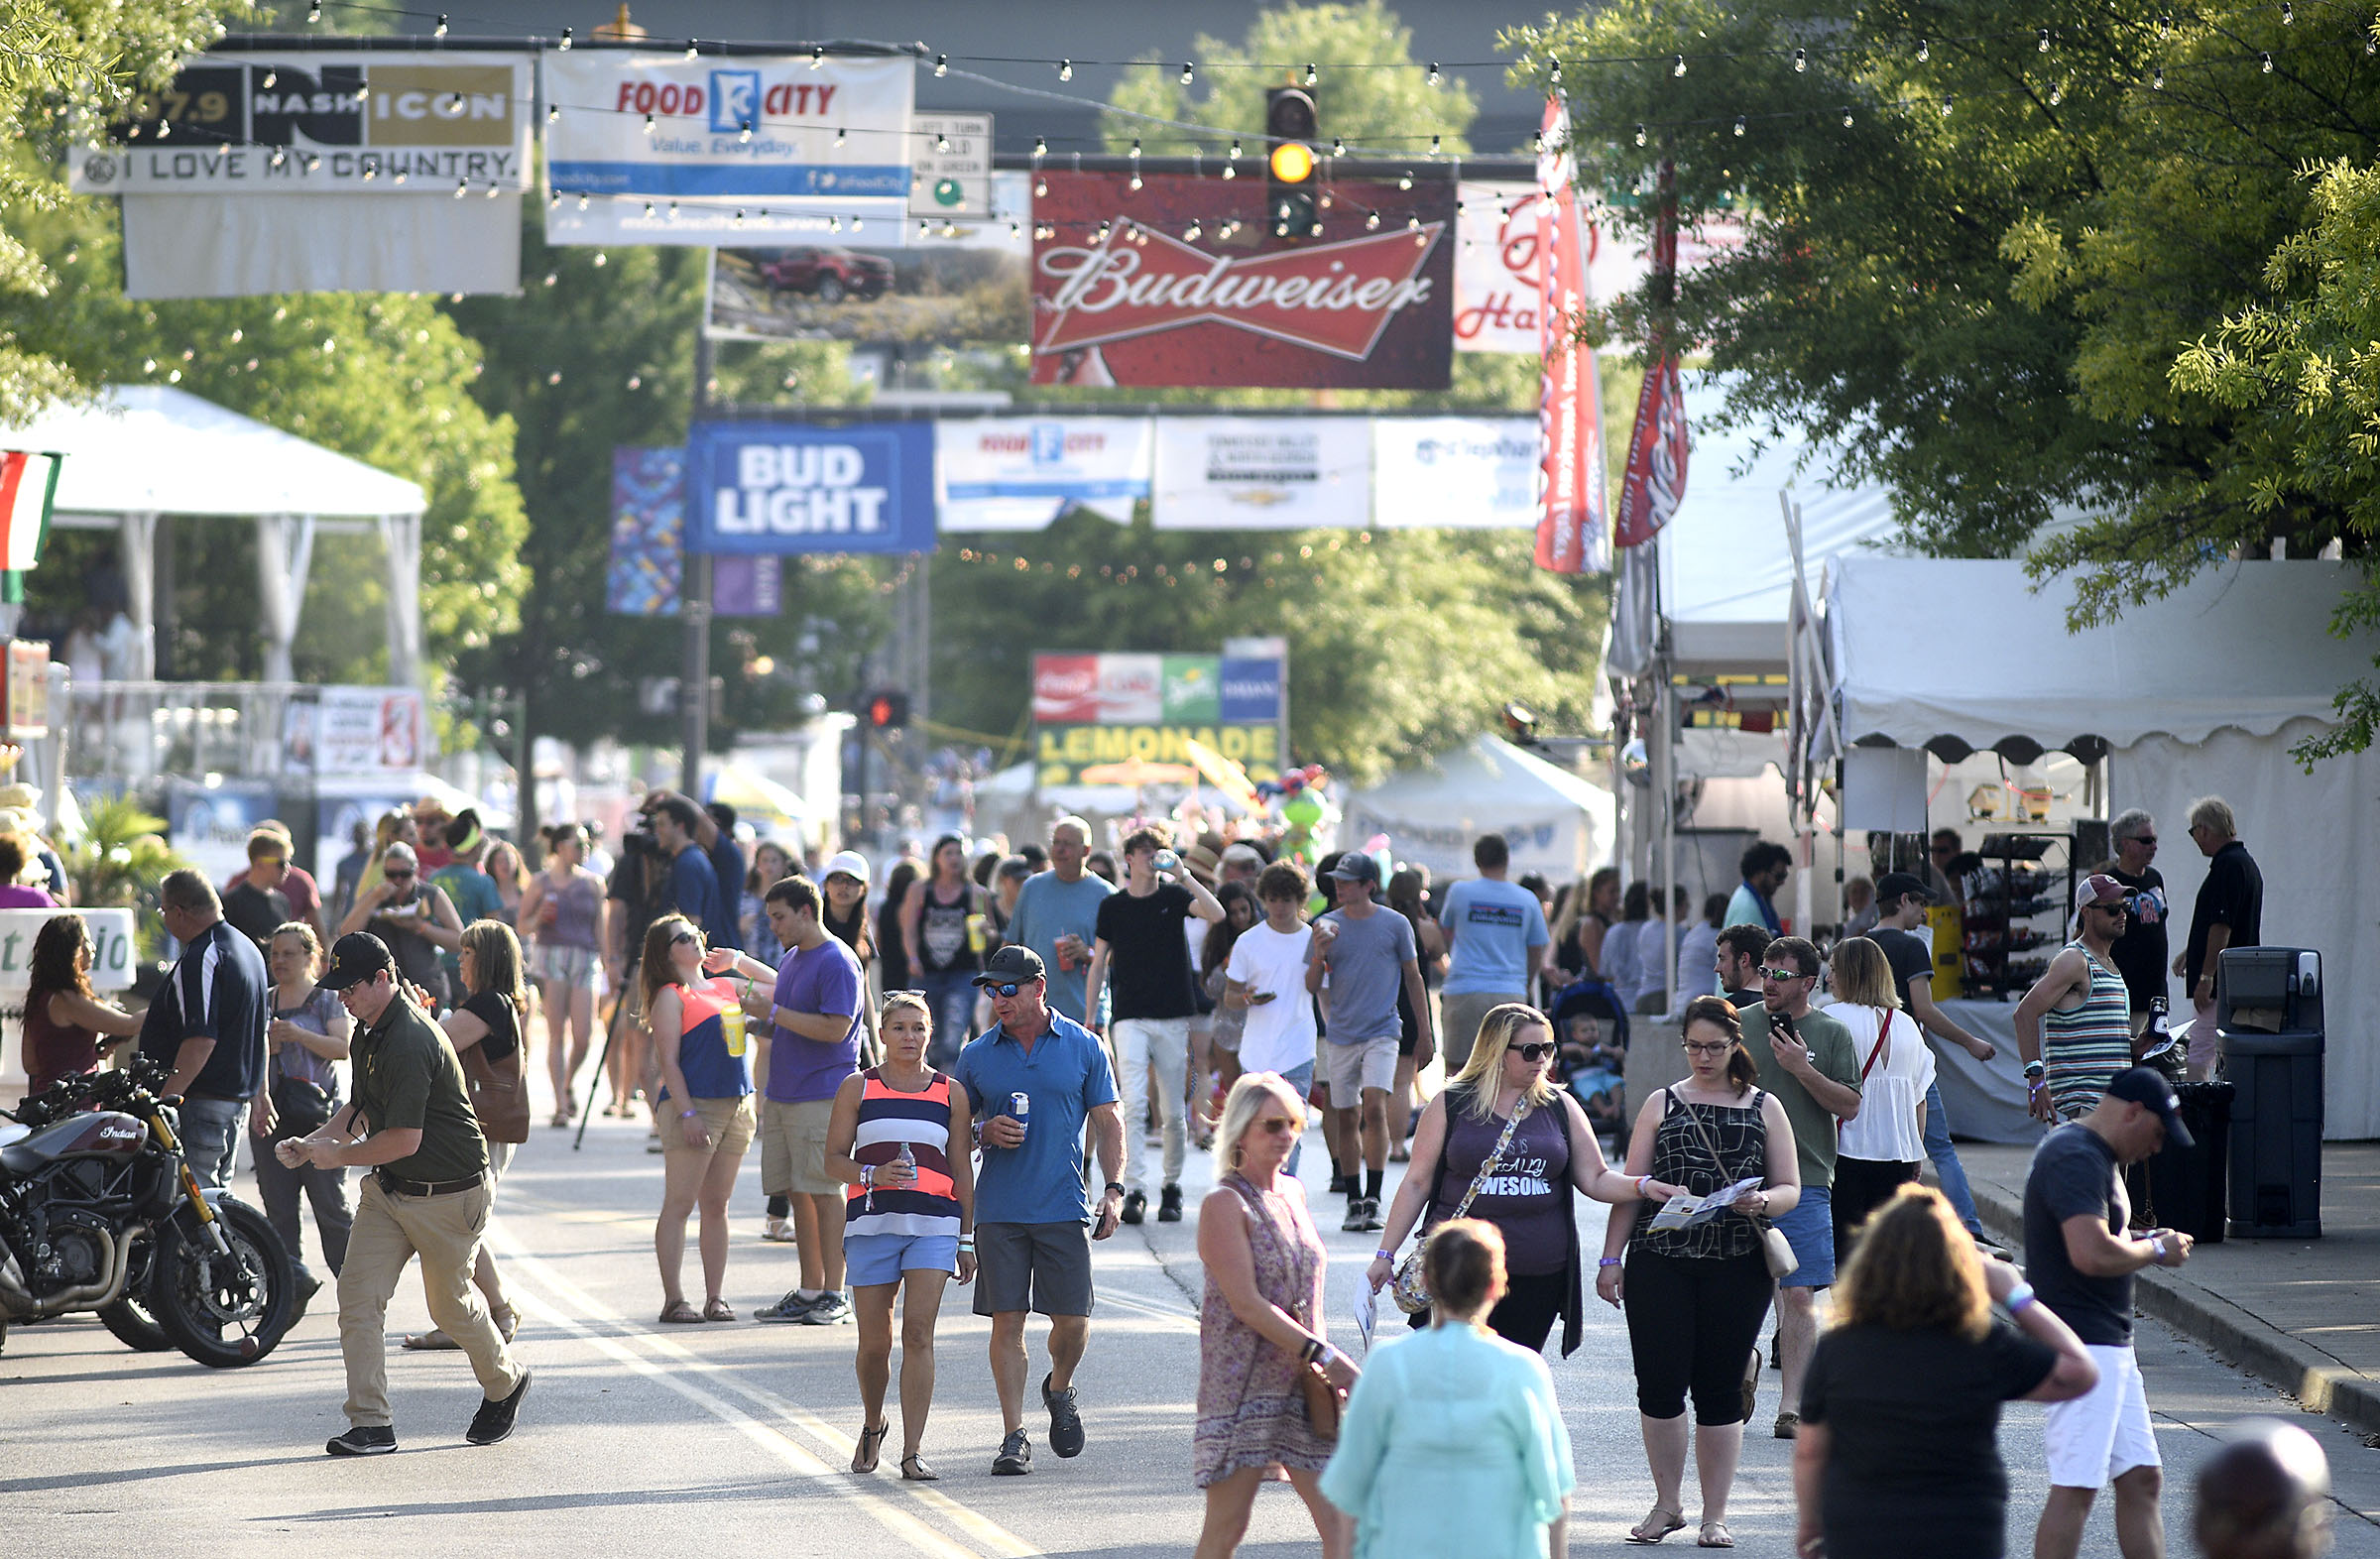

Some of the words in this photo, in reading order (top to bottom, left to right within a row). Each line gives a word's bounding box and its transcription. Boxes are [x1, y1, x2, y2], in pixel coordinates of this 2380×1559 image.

[254, 92, 361, 114] NASH
[376, 92, 507, 120] ICON
[617, 81, 705, 115] FOOD
[766, 84, 837, 116] CITY
[151, 154, 247, 179] LOVE
[264, 153, 316, 177] MY
[331, 152, 520, 178] COUNTRY.
[1037, 246, 1435, 313] Budweiser
[739, 445, 865, 490] BUD
[715, 487, 889, 536] LIGHT
[1041, 726, 1278, 763] LEMONADE
[100, 1126, 137, 1139] Indian
